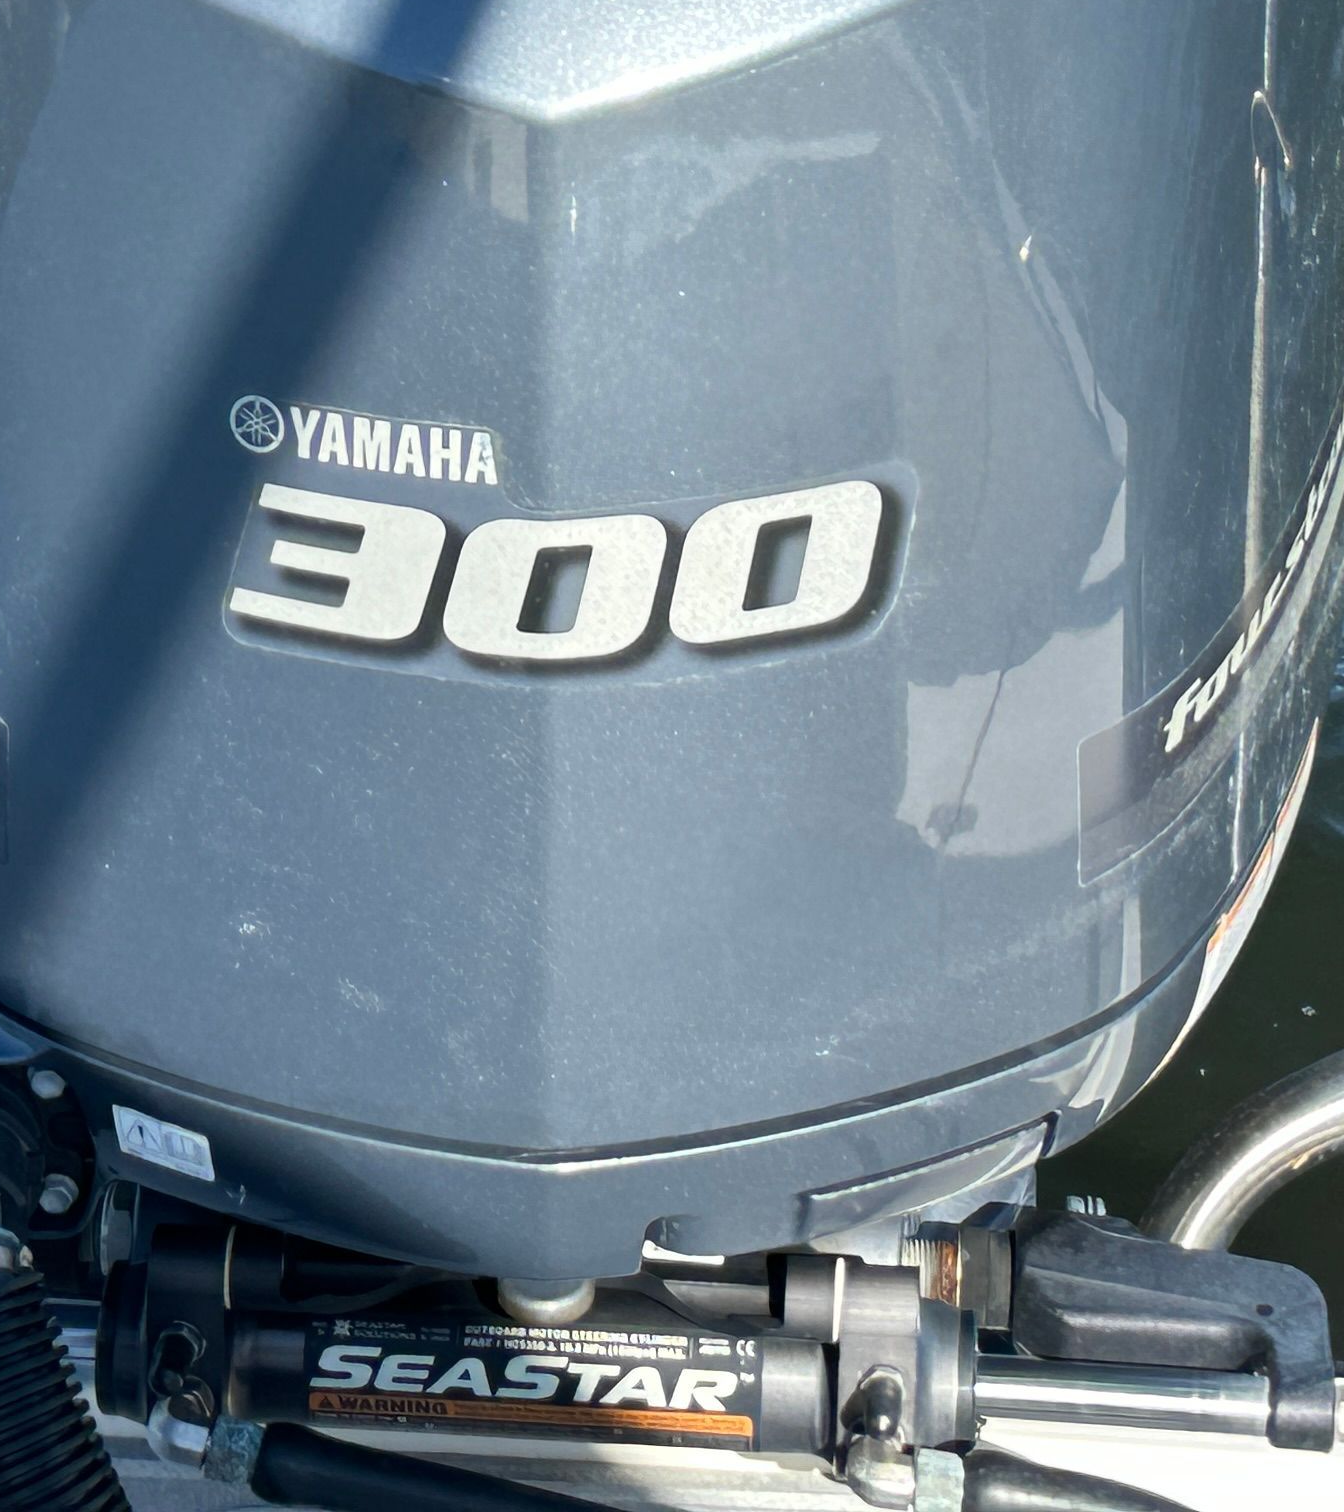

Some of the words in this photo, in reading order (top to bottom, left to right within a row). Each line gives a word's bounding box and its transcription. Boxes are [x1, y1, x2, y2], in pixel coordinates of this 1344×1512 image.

[289, 405, 499, 486] YAMAHA
[229, 480, 884, 662] 300
[309, 1345, 738, 1412] SEASTAR
[338, 1394, 448, 1415] WARNING
